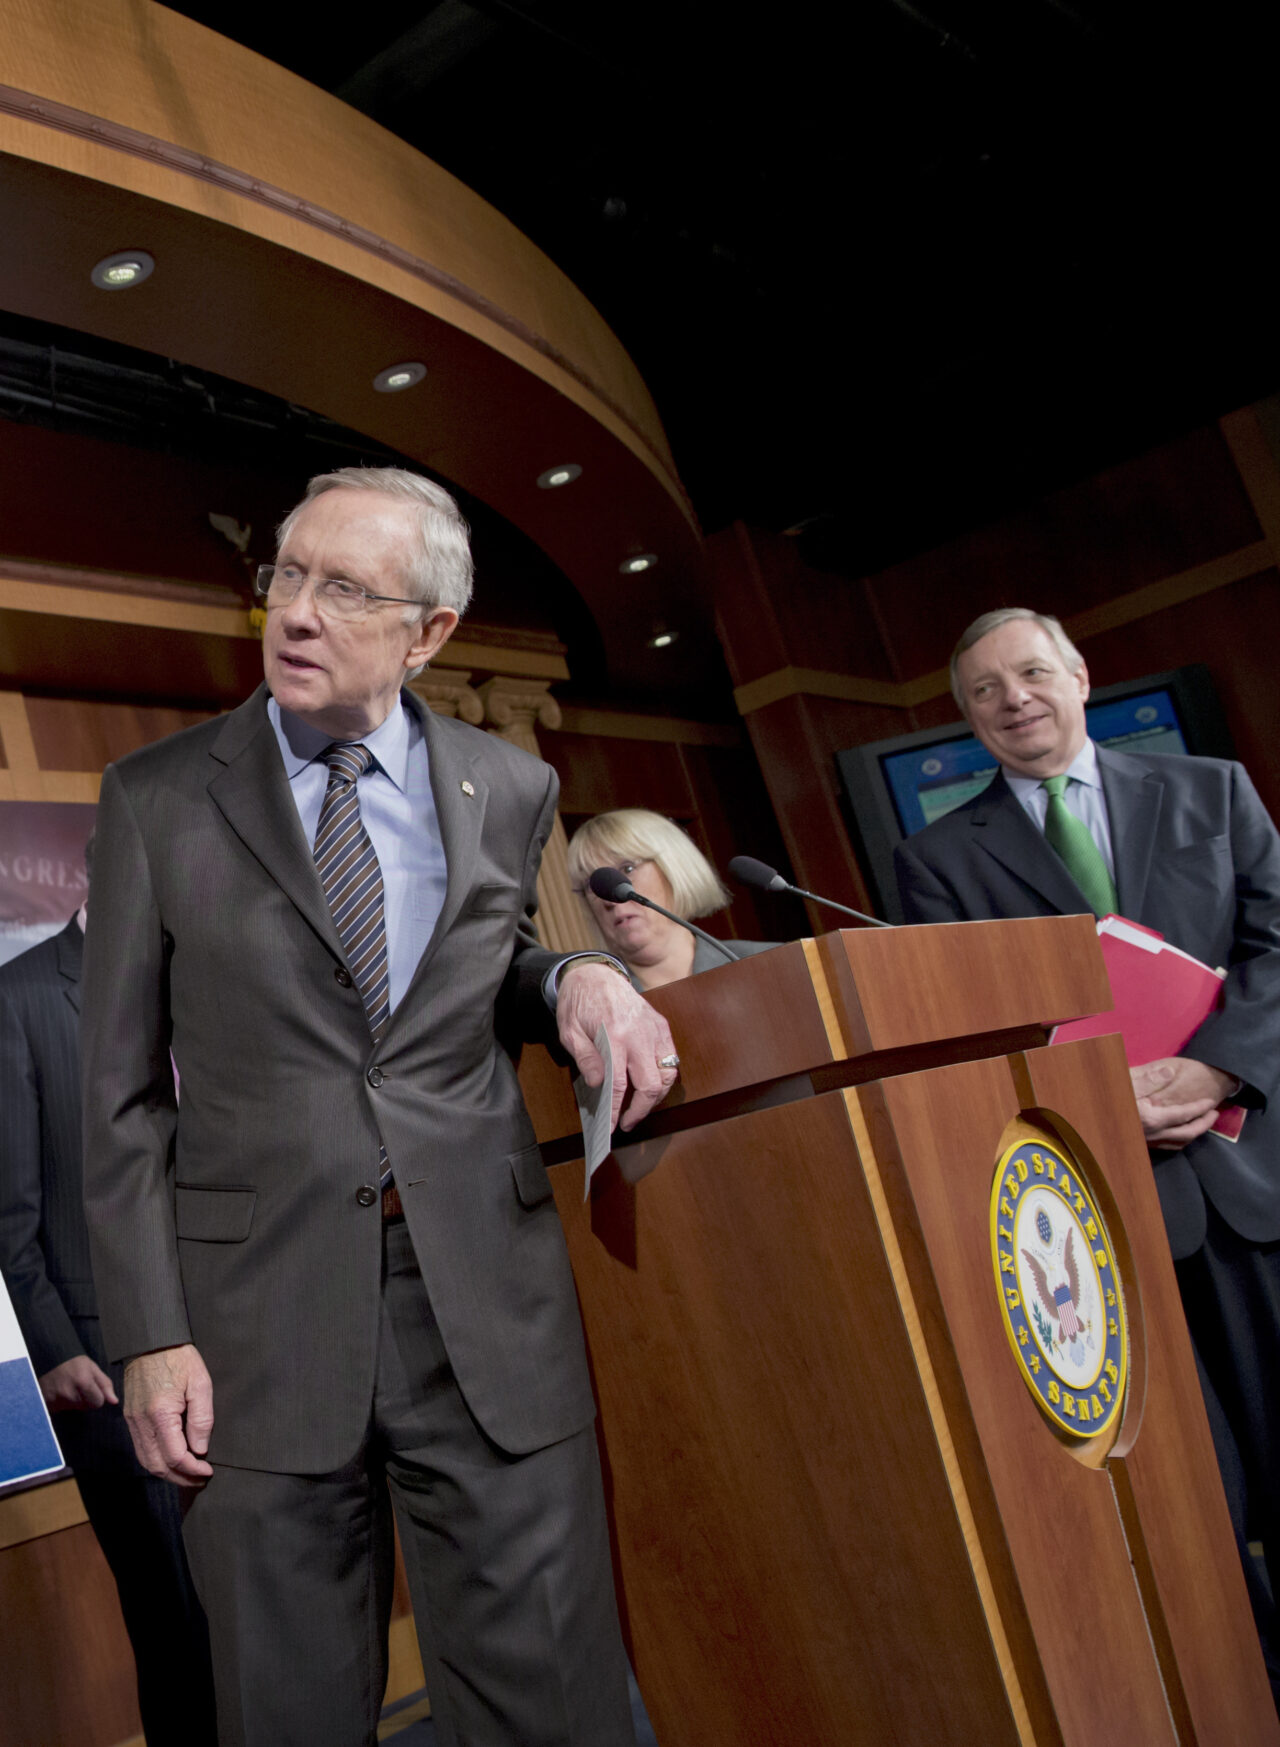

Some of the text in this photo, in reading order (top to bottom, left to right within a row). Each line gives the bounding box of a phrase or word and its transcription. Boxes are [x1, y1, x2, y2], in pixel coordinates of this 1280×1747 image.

[999, 1152, 1108, 1311] UNITED STATES
[1047, 1358, 1119, 1422] SENATE
